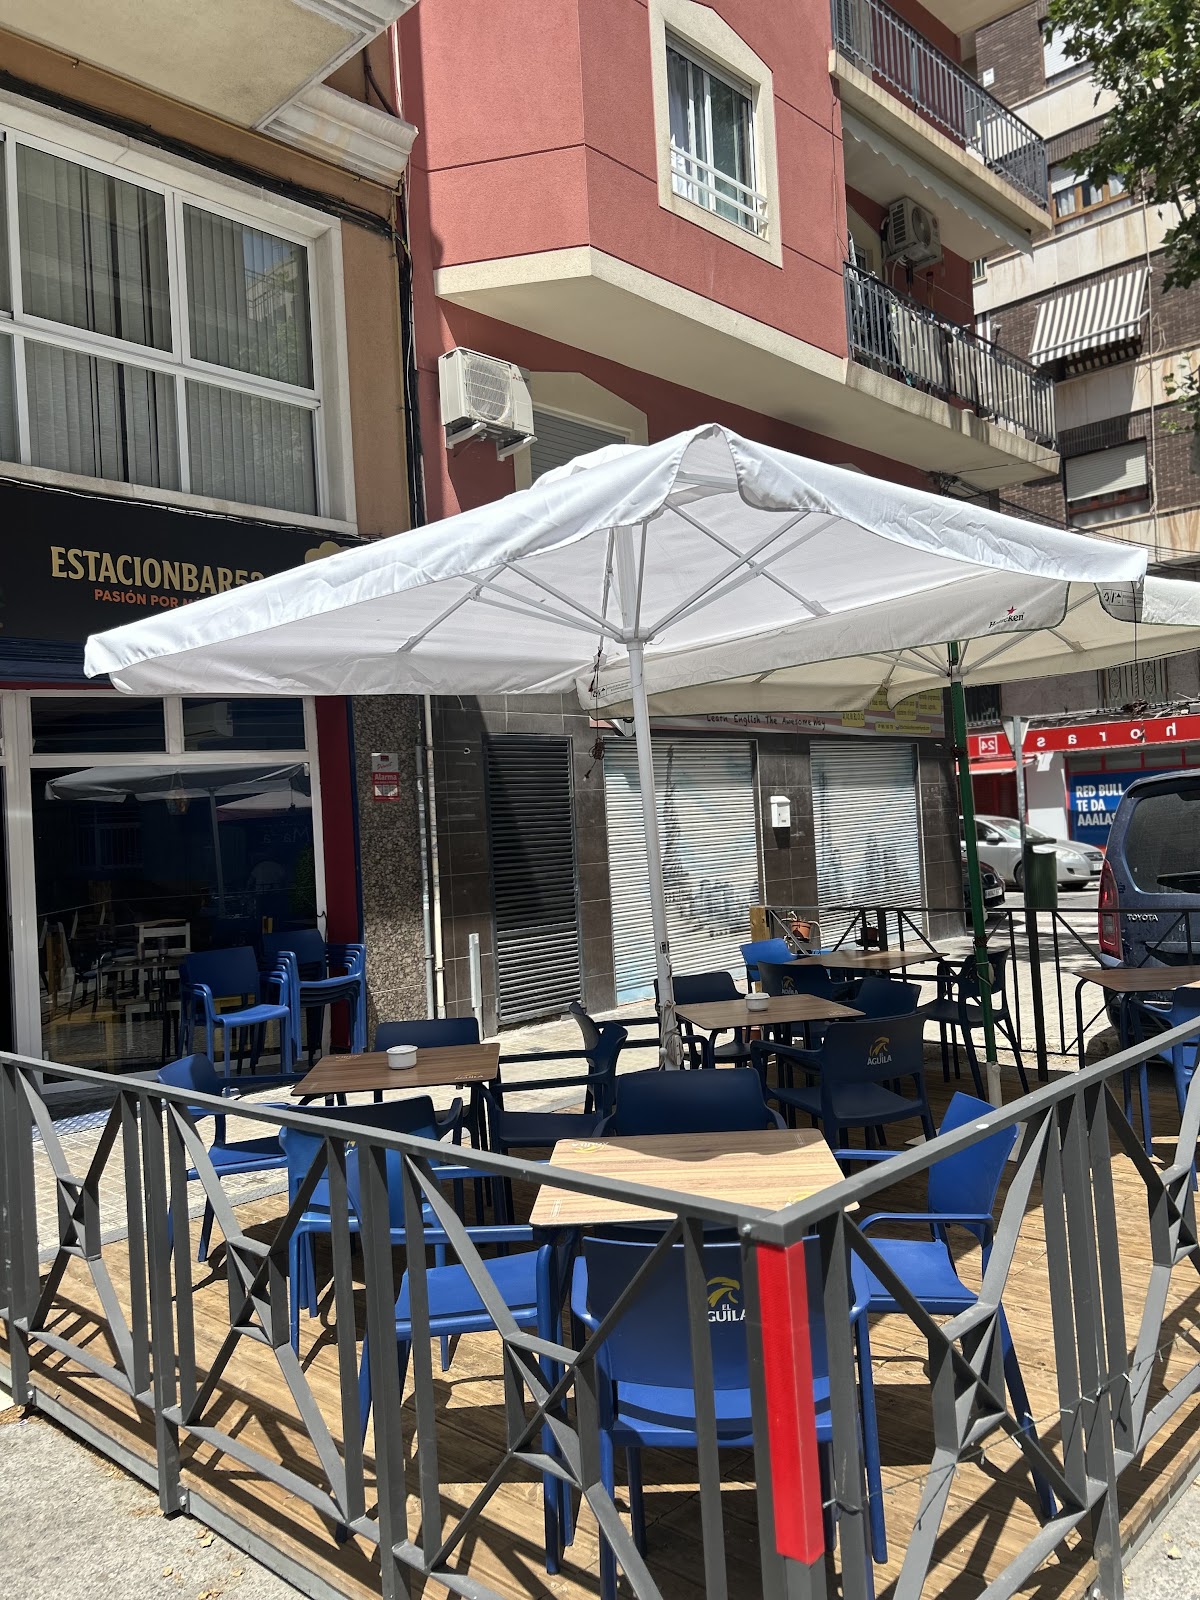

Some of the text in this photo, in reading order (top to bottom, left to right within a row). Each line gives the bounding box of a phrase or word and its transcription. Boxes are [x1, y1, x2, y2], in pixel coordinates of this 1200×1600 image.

[94, 588, 147, 606] PASIÓN
[150, 596, 179, 608] POR
[706, 714, 728, 722] Learn
[733, 714, 761, 727] English
[764, 715, 778, 725] The
[782, 717, 812, 726] Awesome
[374, 773, 398, 781] Alarma
[1075, 783, 1124, 798] RED BULL
[1076, 798, 1106, 812] TE DA
[1126, 913, 1159, 922] TOYOTA
[721, 1303, 731, 1311] EL
[707, 1308, 746, 1322] GUILA
